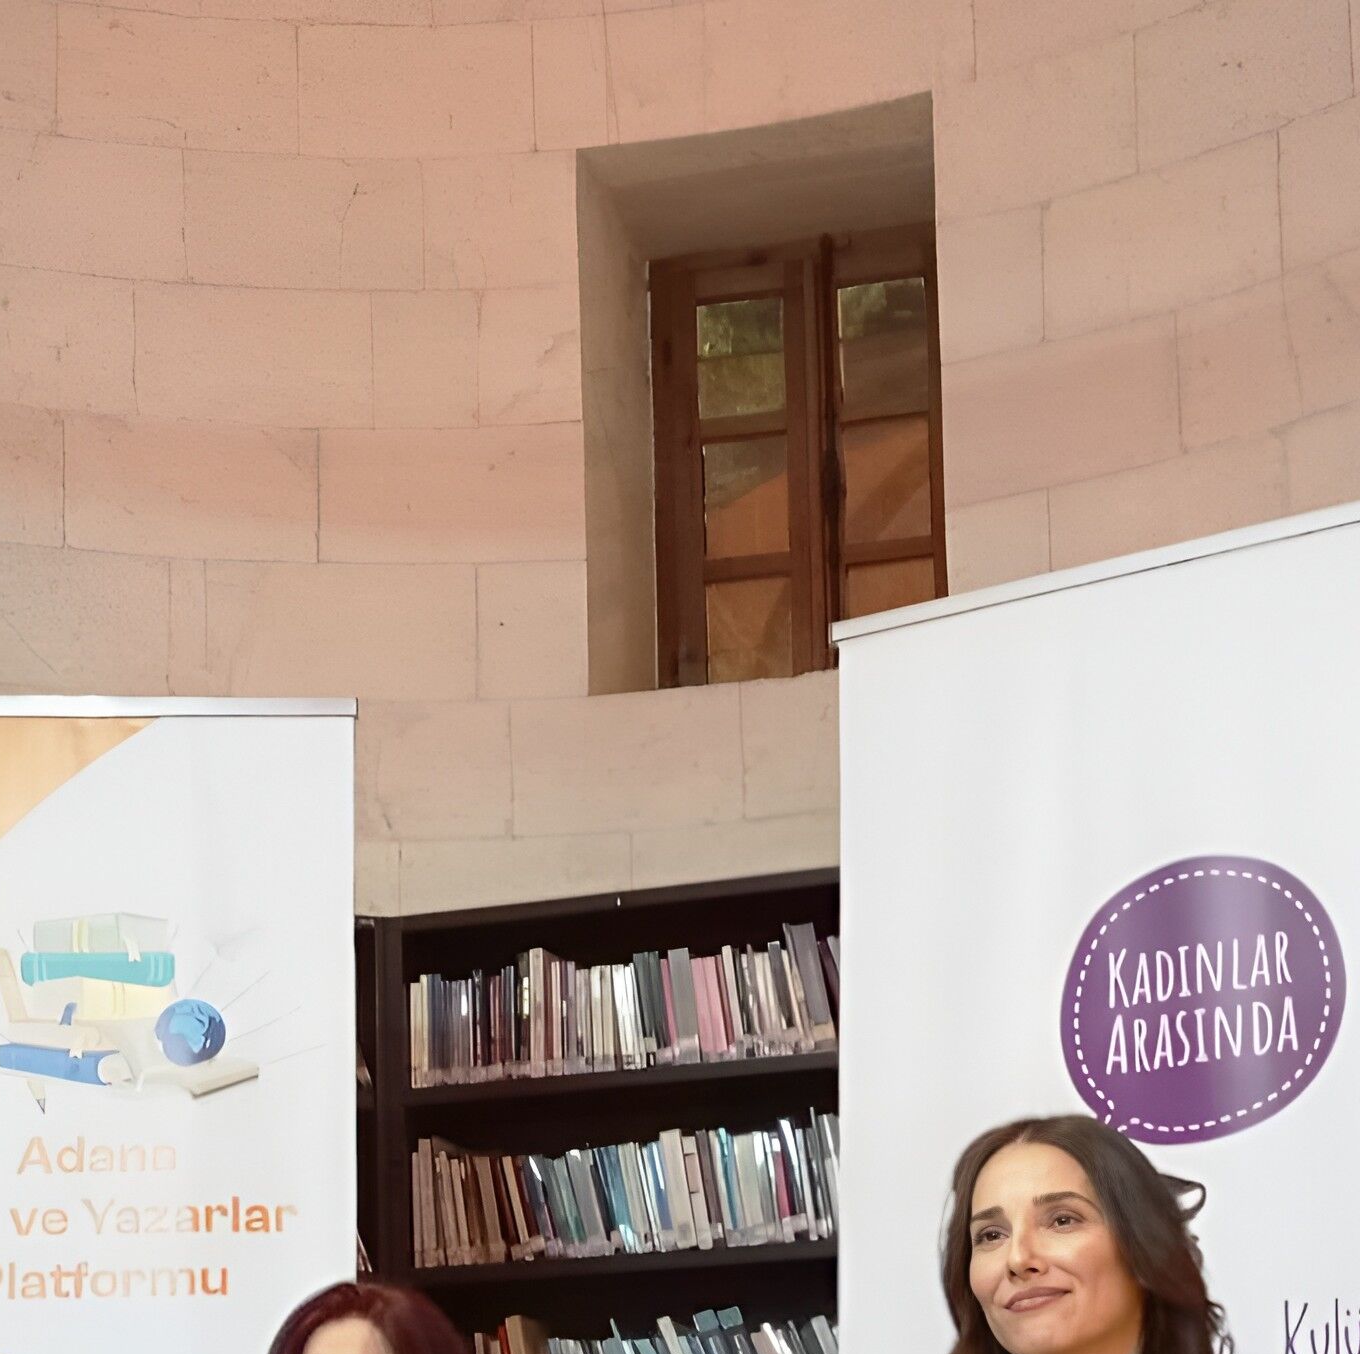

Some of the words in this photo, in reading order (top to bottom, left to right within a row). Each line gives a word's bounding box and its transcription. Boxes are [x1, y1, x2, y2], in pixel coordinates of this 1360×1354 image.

[1107, 930, 1294, 1009] KADINLAR
[1105, 996, 1300, 1076] ARASINDA
[17, 1136, 178, 1175] Adana
[9, 1207, 69, 1237] ve
[81, 1196, 300, 1236] Yazarlar
